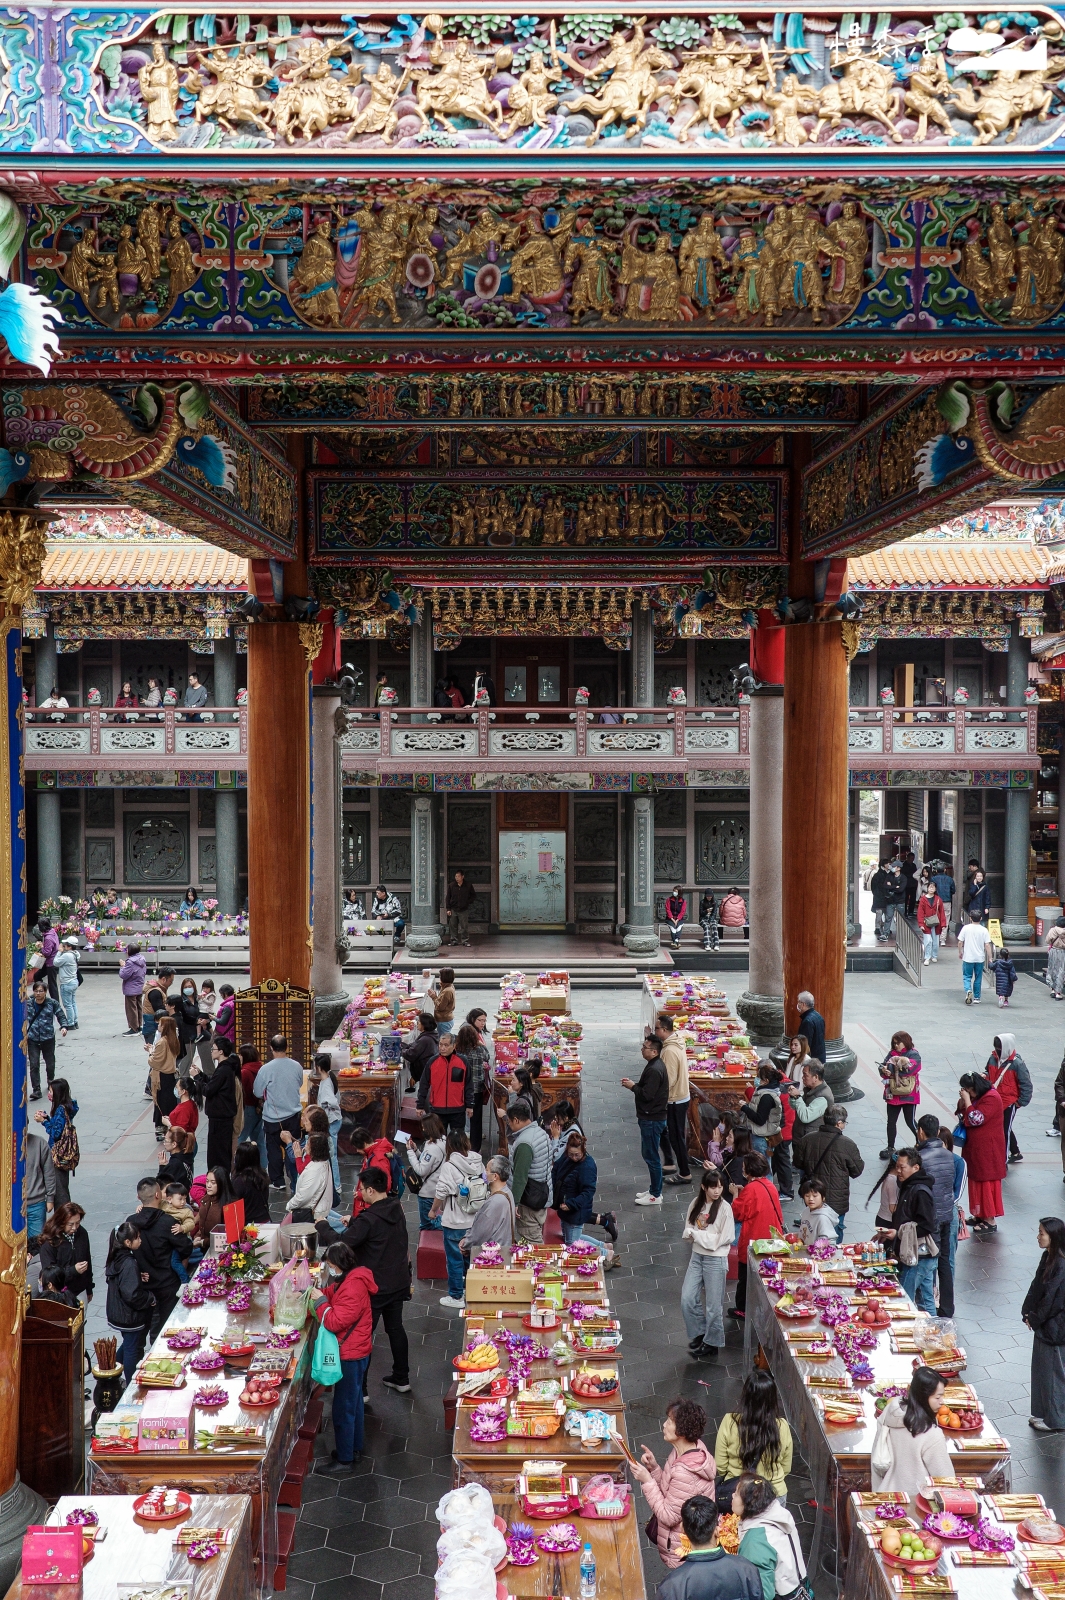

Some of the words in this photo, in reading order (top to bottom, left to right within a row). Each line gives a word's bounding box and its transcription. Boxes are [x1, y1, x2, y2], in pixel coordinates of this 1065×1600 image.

[481, 1285, 517, 1296] 台灣製造
[324, 1355, 335, 1363] EN
[142, 1418, 169, 1428] family
